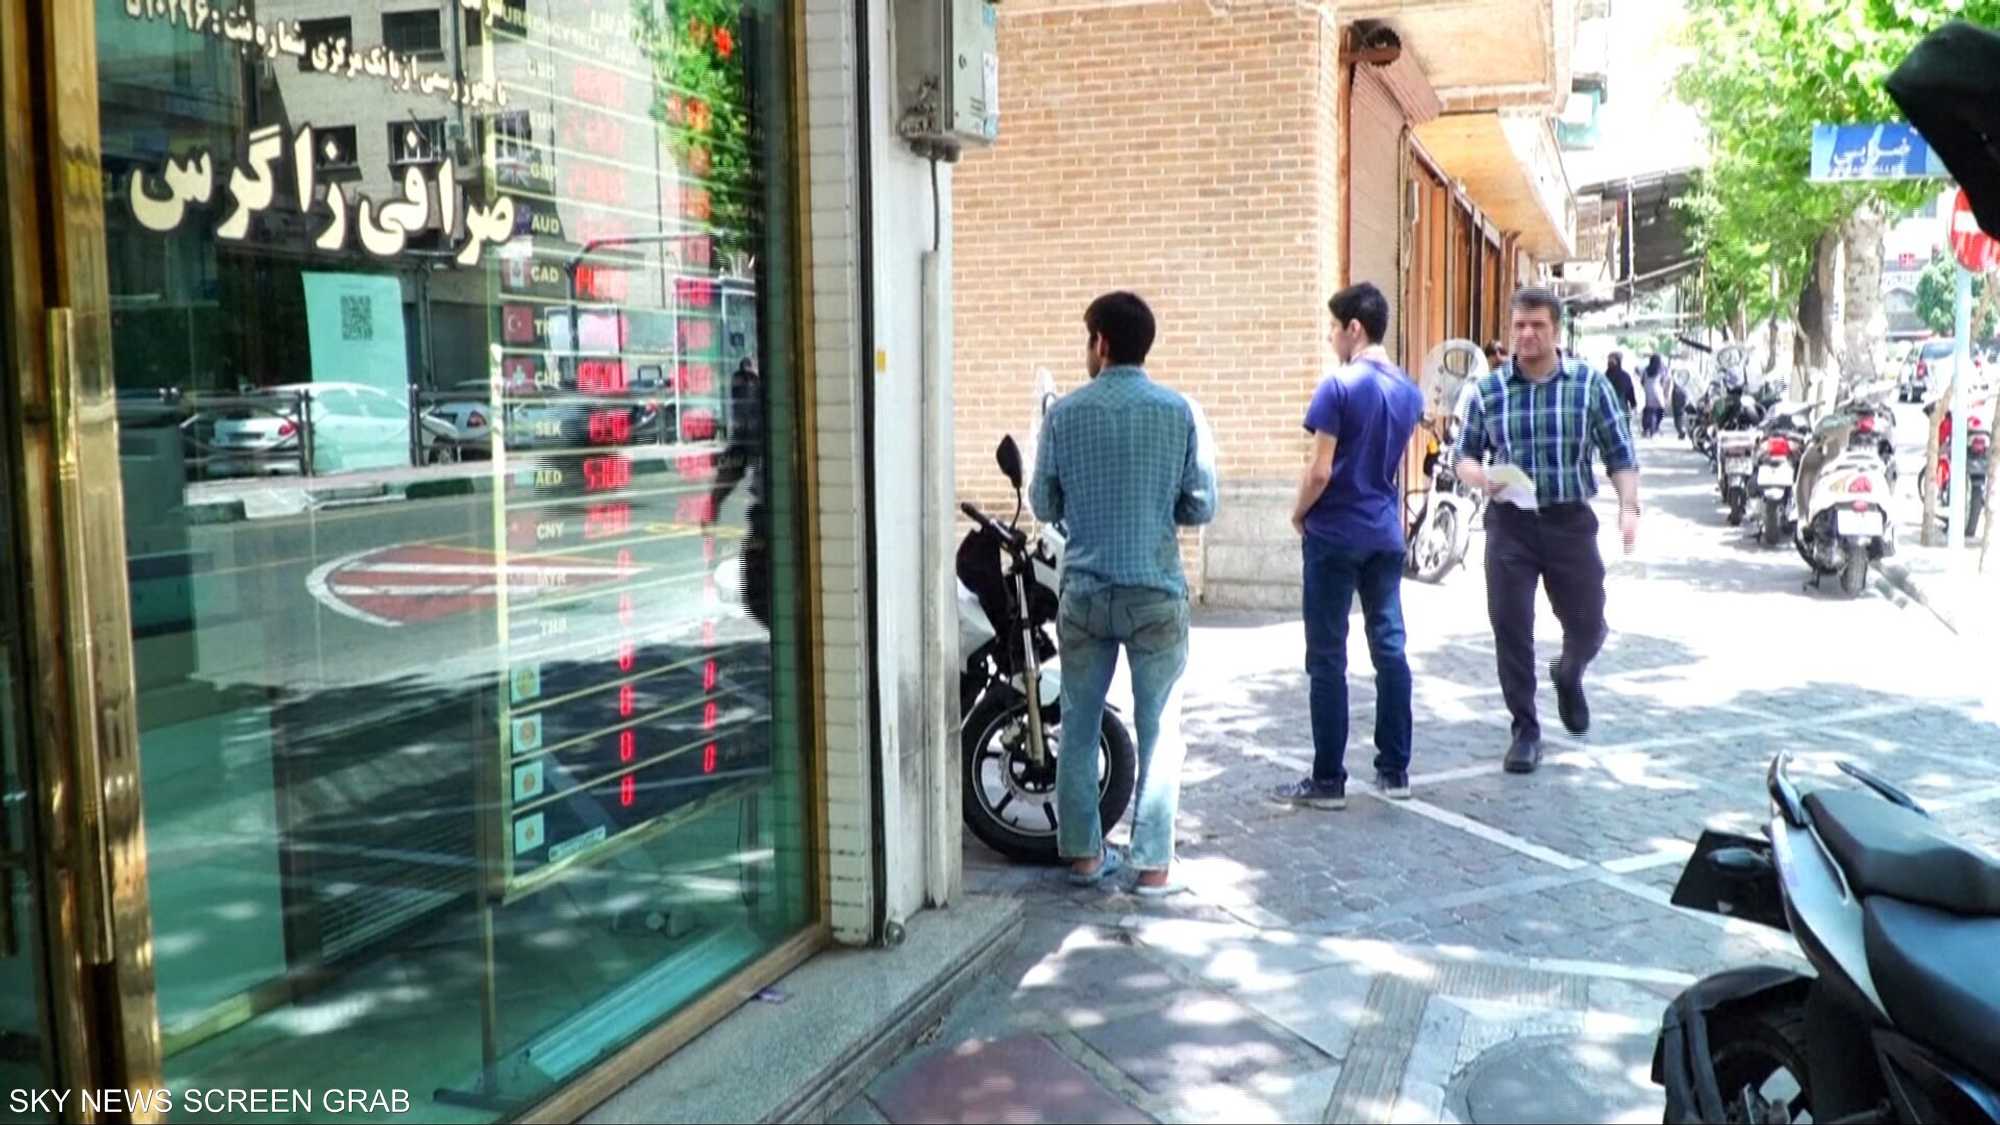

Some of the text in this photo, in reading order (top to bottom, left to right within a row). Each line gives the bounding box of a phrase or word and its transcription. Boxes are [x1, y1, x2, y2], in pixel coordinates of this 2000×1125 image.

[254, 20, 306, 58] شماره
[311, 36, 363, 77] مرکزی
[363, 46, 400, 91] بانک
[401, 54, 418, 90] از
[130, 124, 515, 266] صرافی زاگرس
[531, 215, 560, 235] AUD
[530, 264, 559, 283] CAD
[535, 467, 562, 487] AED
[536, 522, 564, 540] CNY
